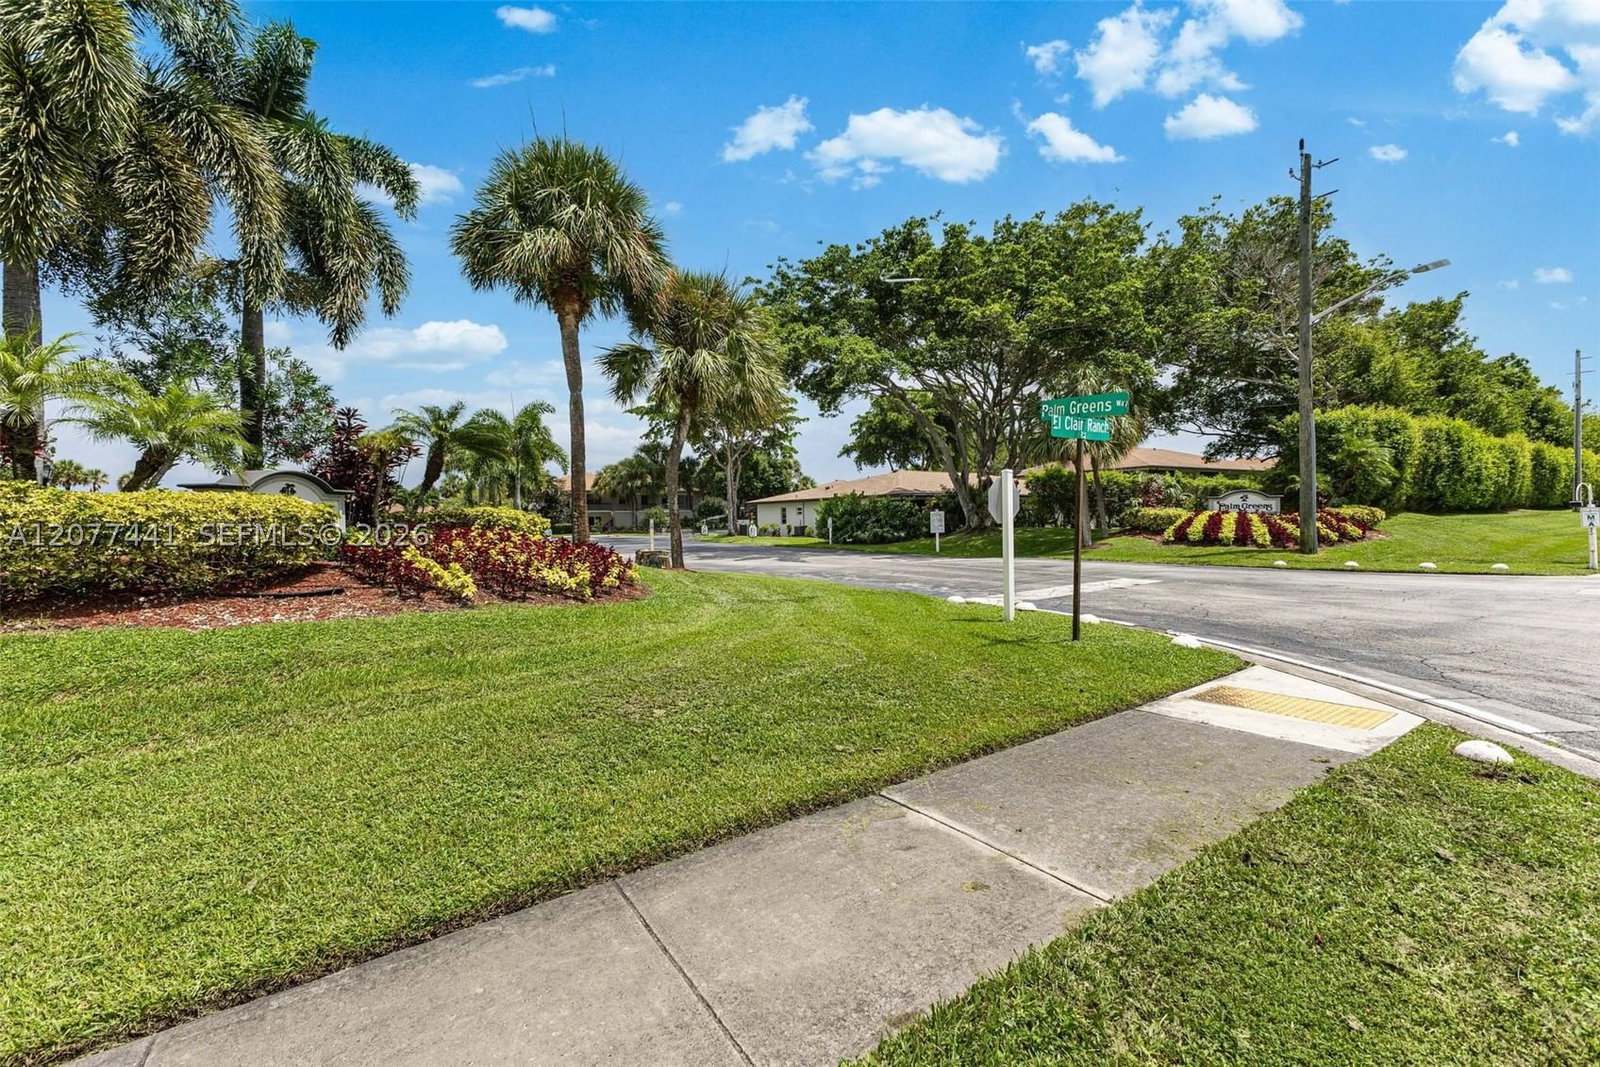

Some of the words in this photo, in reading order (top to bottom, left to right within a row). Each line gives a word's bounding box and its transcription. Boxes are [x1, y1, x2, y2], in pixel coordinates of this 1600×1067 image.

[1042, 404, 1065, 418] Palm
[1070, 400, 1112, 415] Greens
[1053, 415, 1061, 430] El
[1064, 416, 1084, 431] Clair
[1087, 418, 1109, 433] Ranch
[1216, 501, 1240, 511] Palm
[1241, 502, 1273, 511] Greens
